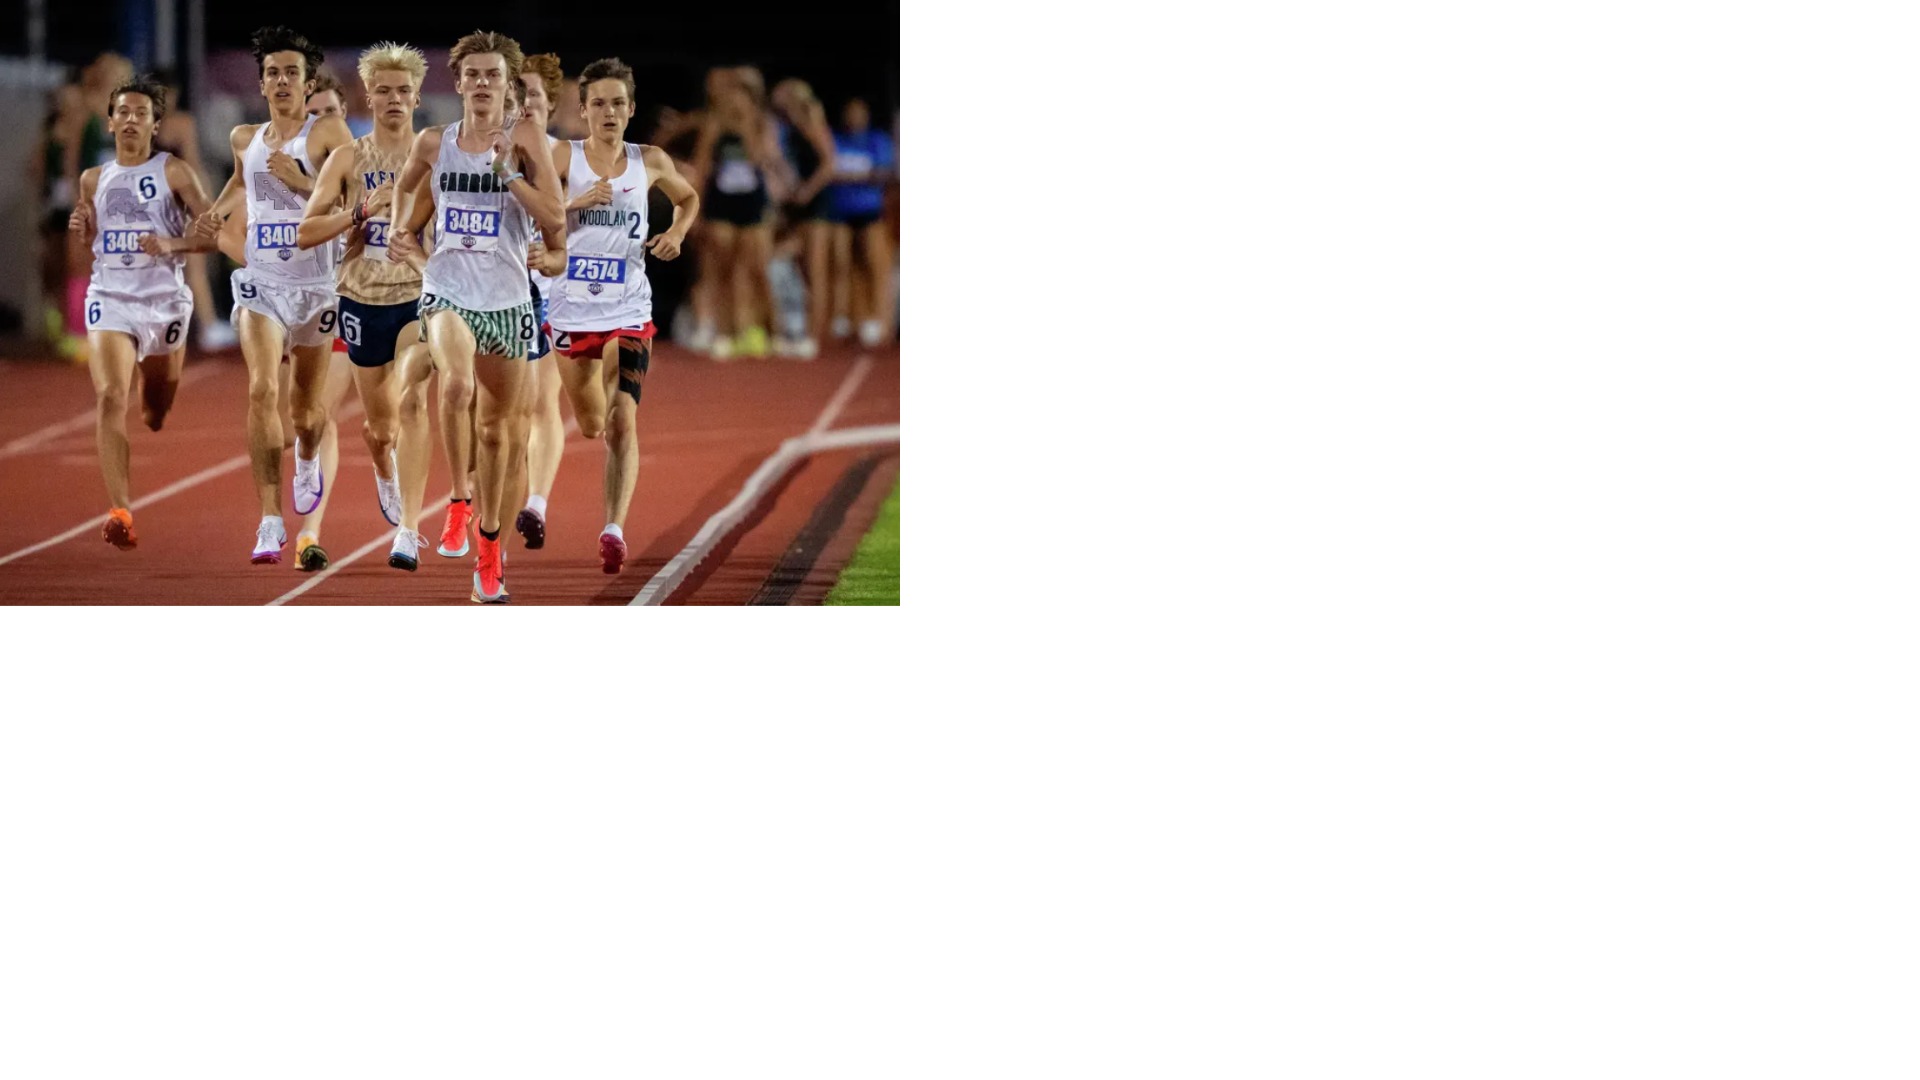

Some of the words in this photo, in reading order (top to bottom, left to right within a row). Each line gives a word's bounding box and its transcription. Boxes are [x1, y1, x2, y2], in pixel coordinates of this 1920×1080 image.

[139, 176, 156, 199] 6
[449, 210, 494, 234] 3484
[628, 212, 641, 239] 2
[106, 231, 150, 252] 340
[261, 225, 297, 246] 340
[574, 258, 619, 281] 2574
[240, 283, 257, 298] 9
[89, 301, 101, 325] 6
[318, 310, 337, 333] 9
[165, 321, 182, 344] 6
[344, 315, 358, 341] 5
[520, 314, 534, 340] 8
